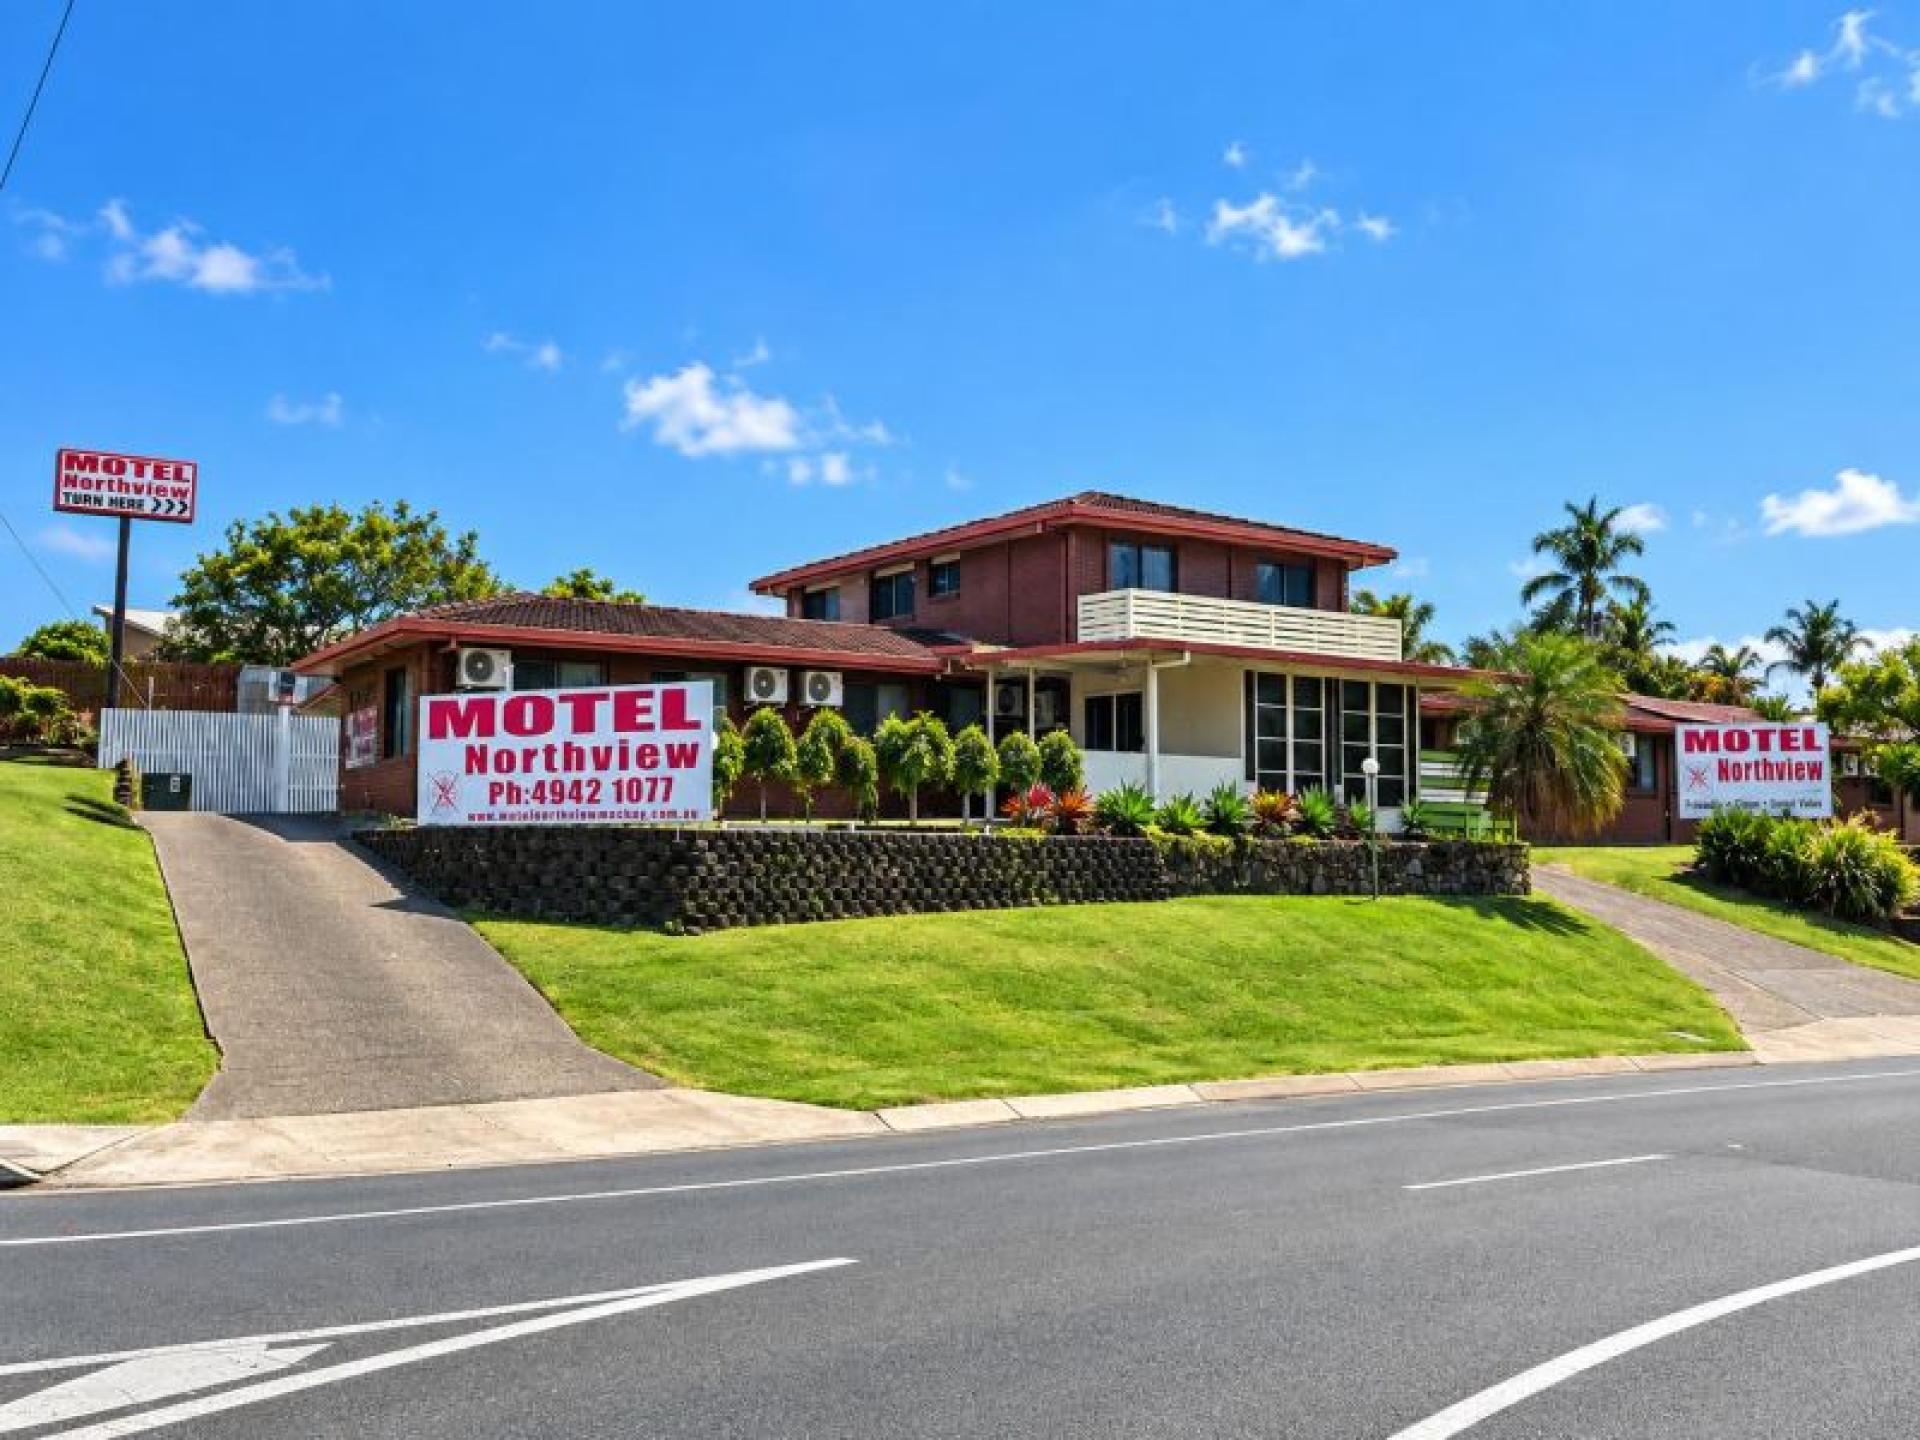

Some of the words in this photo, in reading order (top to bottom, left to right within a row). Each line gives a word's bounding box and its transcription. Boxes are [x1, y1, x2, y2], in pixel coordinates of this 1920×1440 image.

[64, 454, 191, 482] MOTEL
[62, 491, 104, 507] TURN
[64, 473, 189, 498] Northview
[428, 688, 702, 740] MOTEL
[1684, 728, 1822, 754] MOTEL
[464, 738, 699, 776] Northview
[1717, 757, 1823, 782] Northview
[488, 778, 602, 806] Ph:4942
[611, 776, 674, 804] 1077
